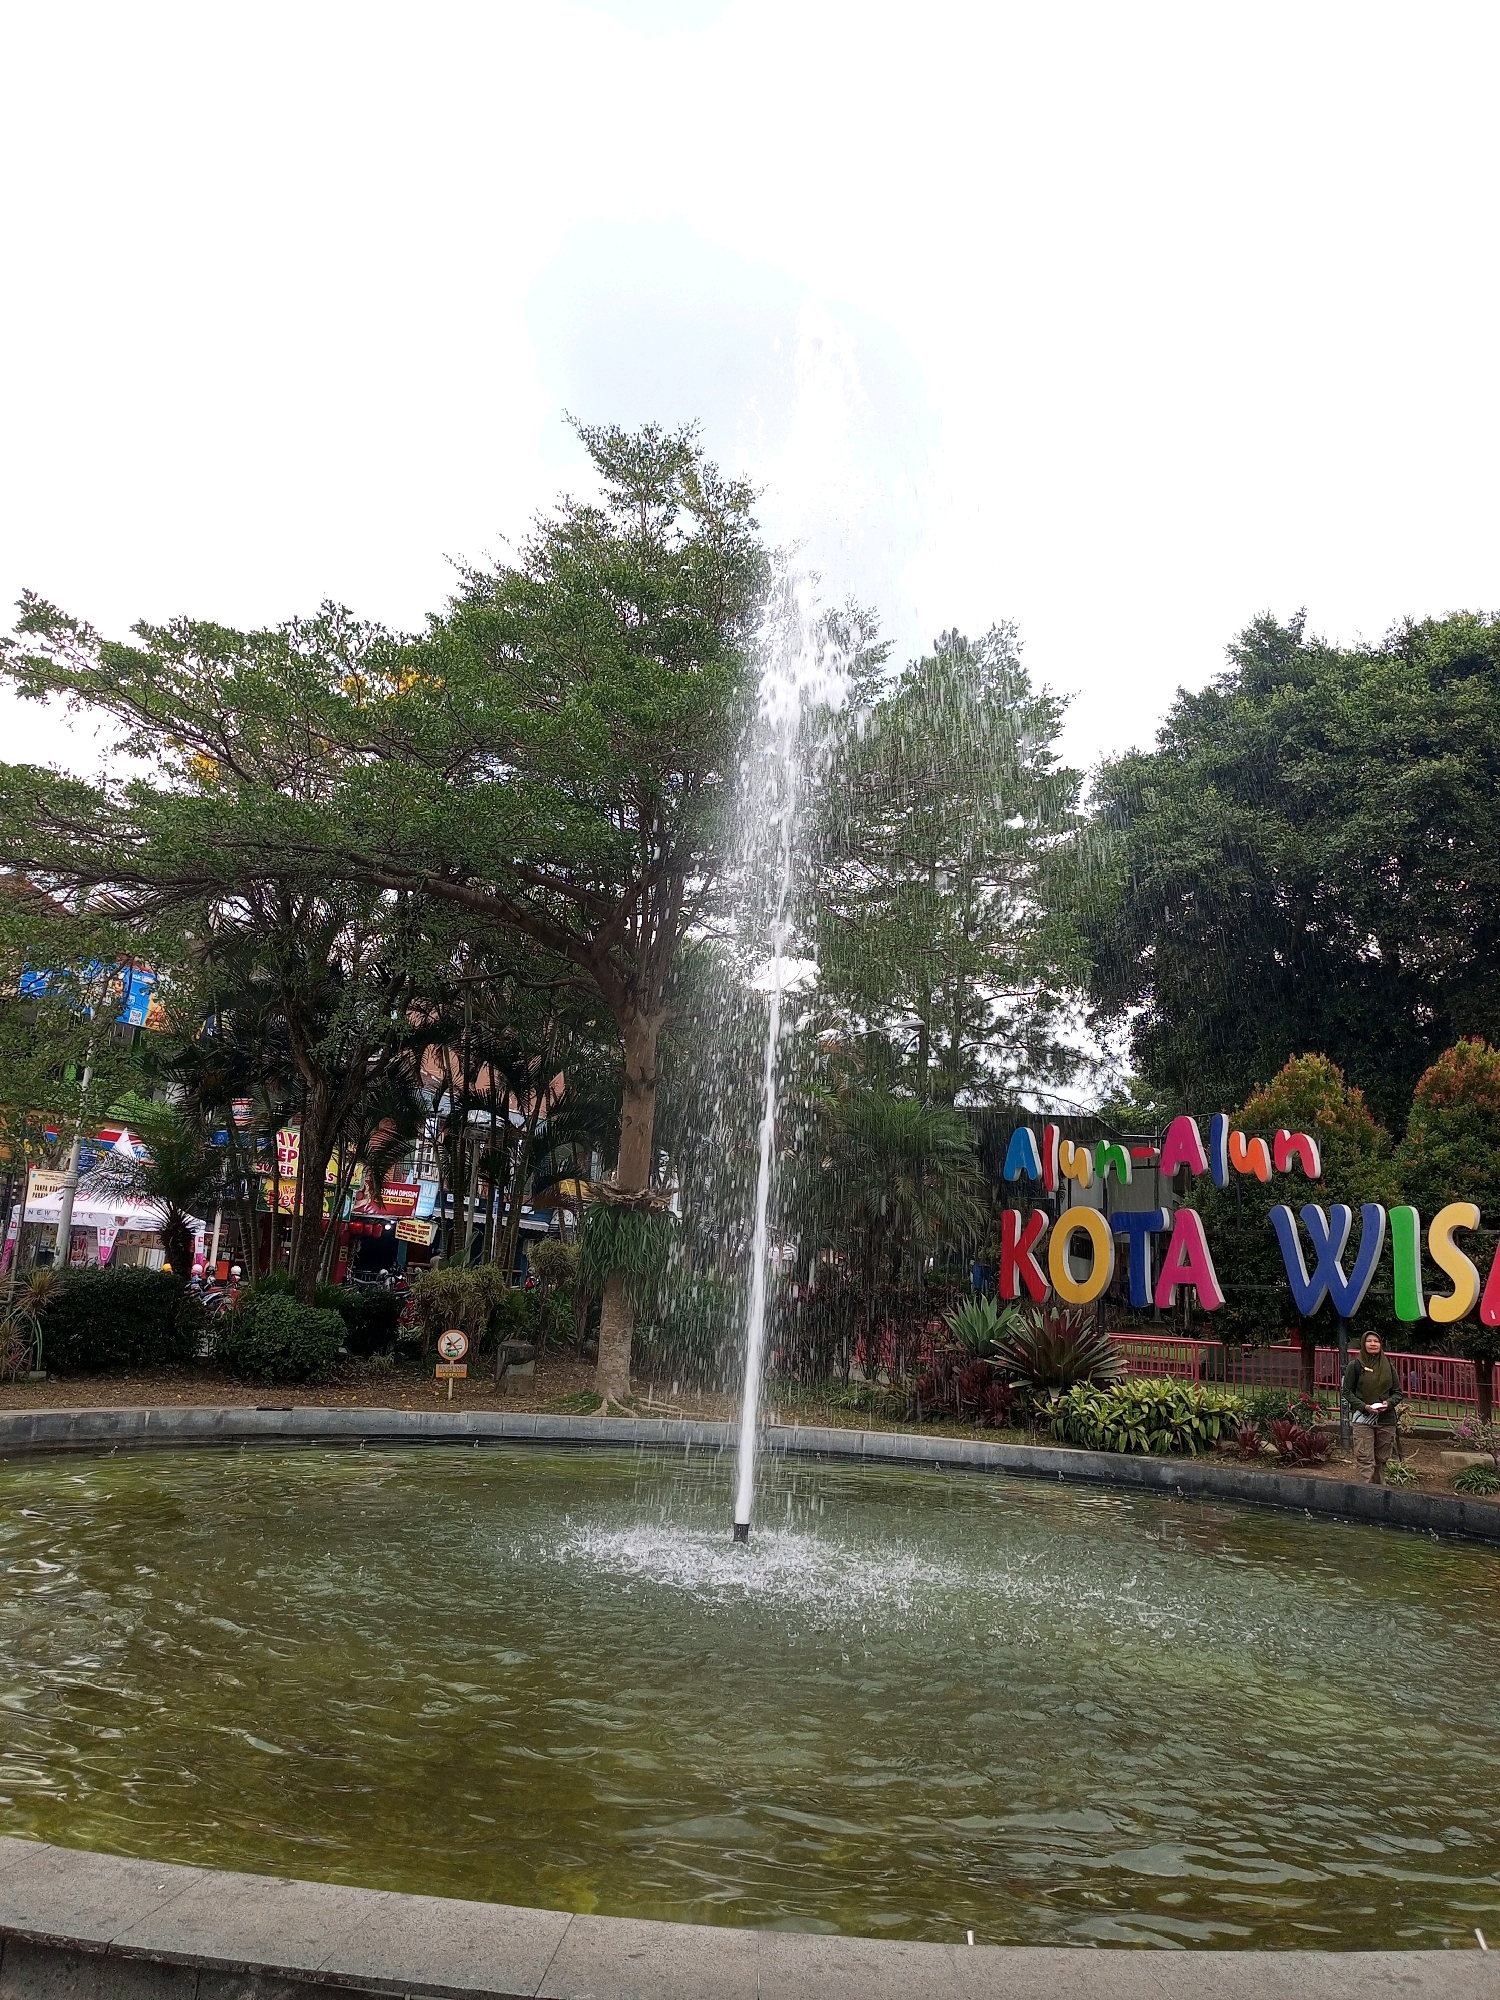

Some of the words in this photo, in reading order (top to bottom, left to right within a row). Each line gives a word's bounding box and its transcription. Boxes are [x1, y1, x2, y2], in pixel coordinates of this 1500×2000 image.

[1003, 1113, 1322, 1193] Alun-Alun
[56, 1210, 94, 1219] TSTE
[1000, 1205, 1227, 1311] KOTA
[1267, 1202, 1500, 1326] WIS
